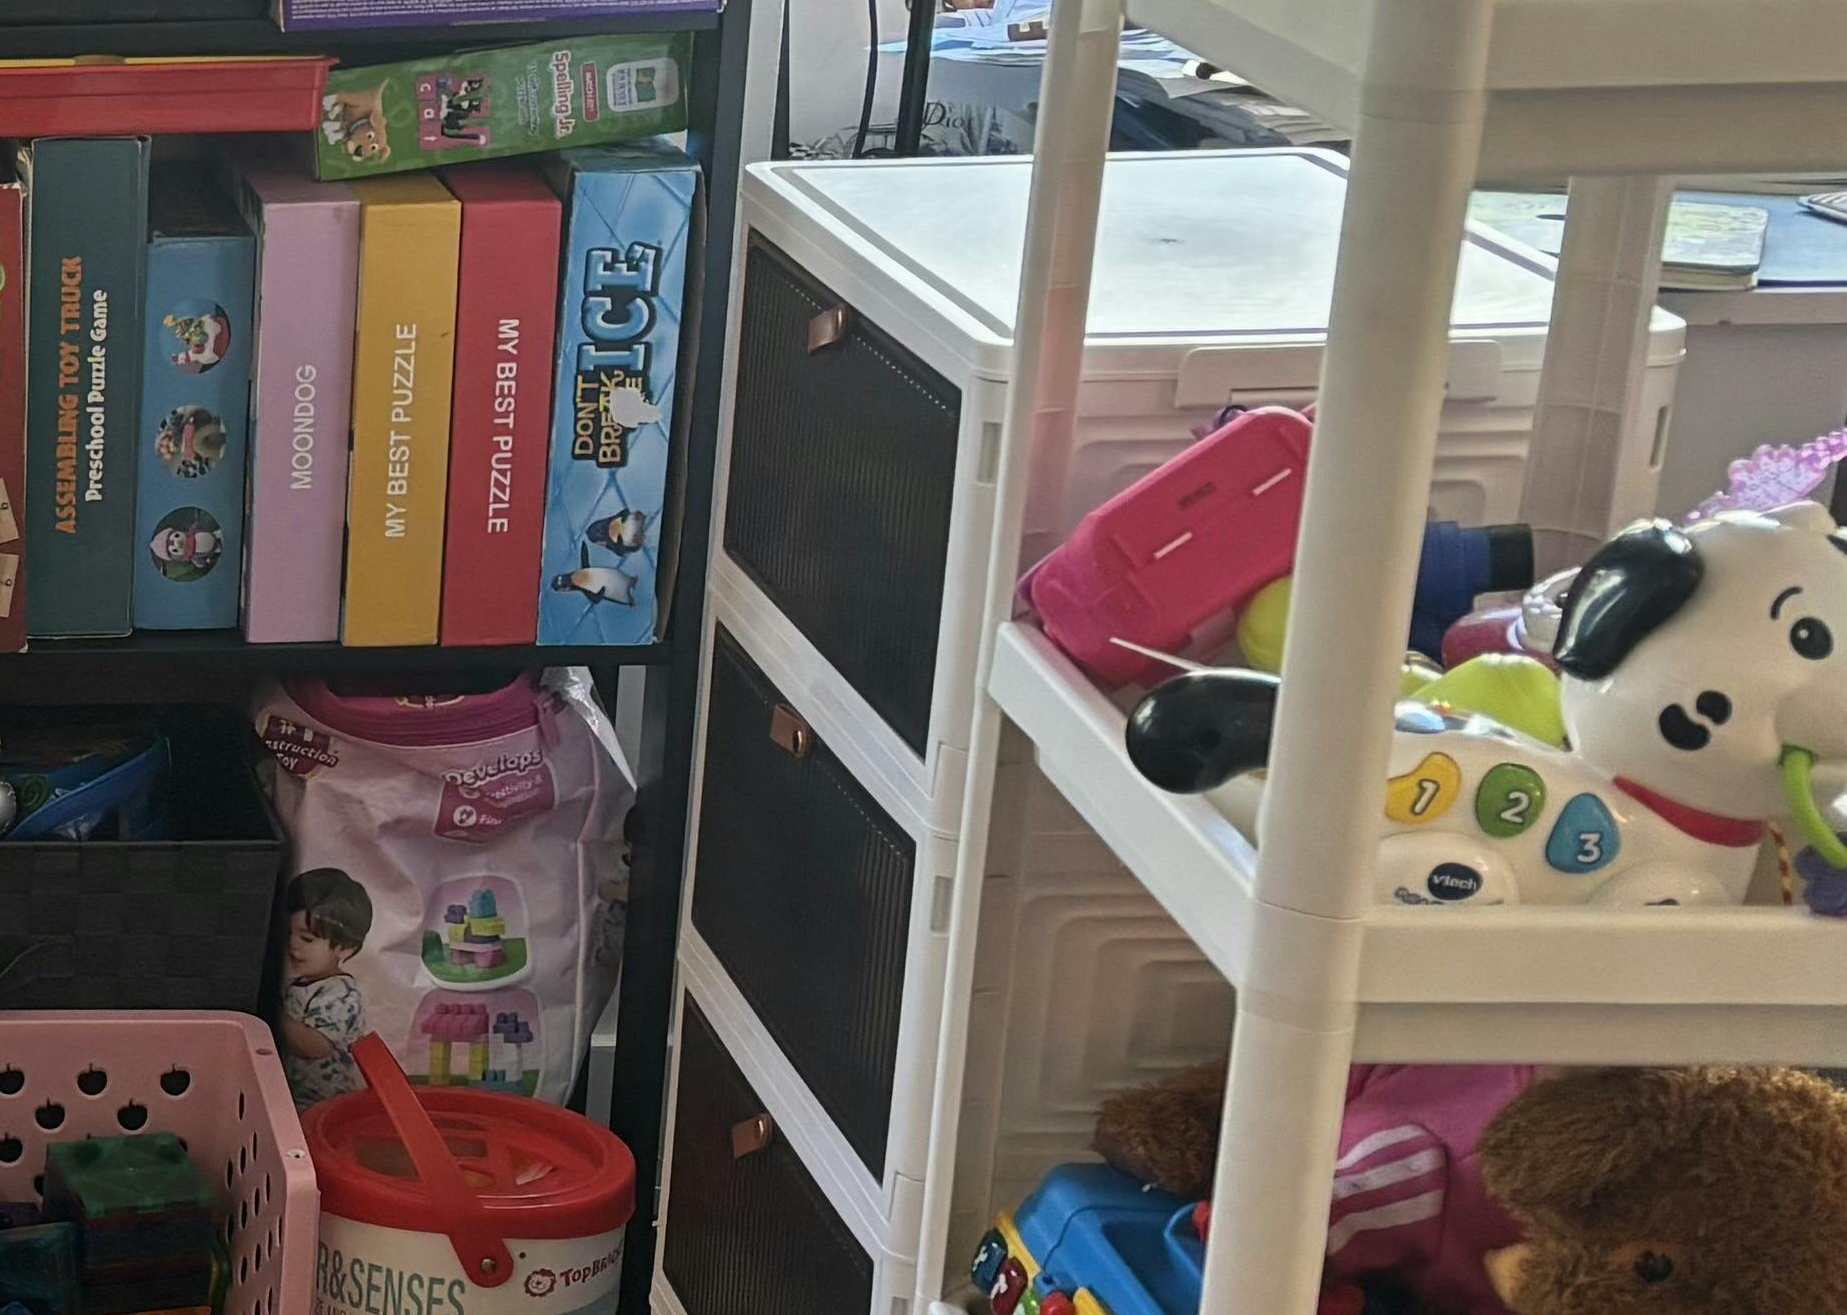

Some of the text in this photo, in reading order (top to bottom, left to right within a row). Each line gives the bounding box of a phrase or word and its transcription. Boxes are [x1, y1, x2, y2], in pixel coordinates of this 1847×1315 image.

[552, 50, 576, 140] Spelling Jr.
[578, 242, 660, 372] ICE
[55, 256, 83, 534] ASSEMBLING TOY TRUCK
[85, 289, 108, 503] Preschool Puzzle Game
[290, 364, 317, 490] MOONDOG
[385, 324, 416, 537] MY BEST PUZZLE
[487, 319, 519, 534] MY BEST PUZZLE
[575, 374, 599, 456] DON'T
[444, 748, 543, 787] Develops
[1412, 780, 1440, 815] 1
[1500, 790, 1530, 825] 2
[1433, 874, 1476, 891] vtech
[1577, 833, 1602, 864] 3
